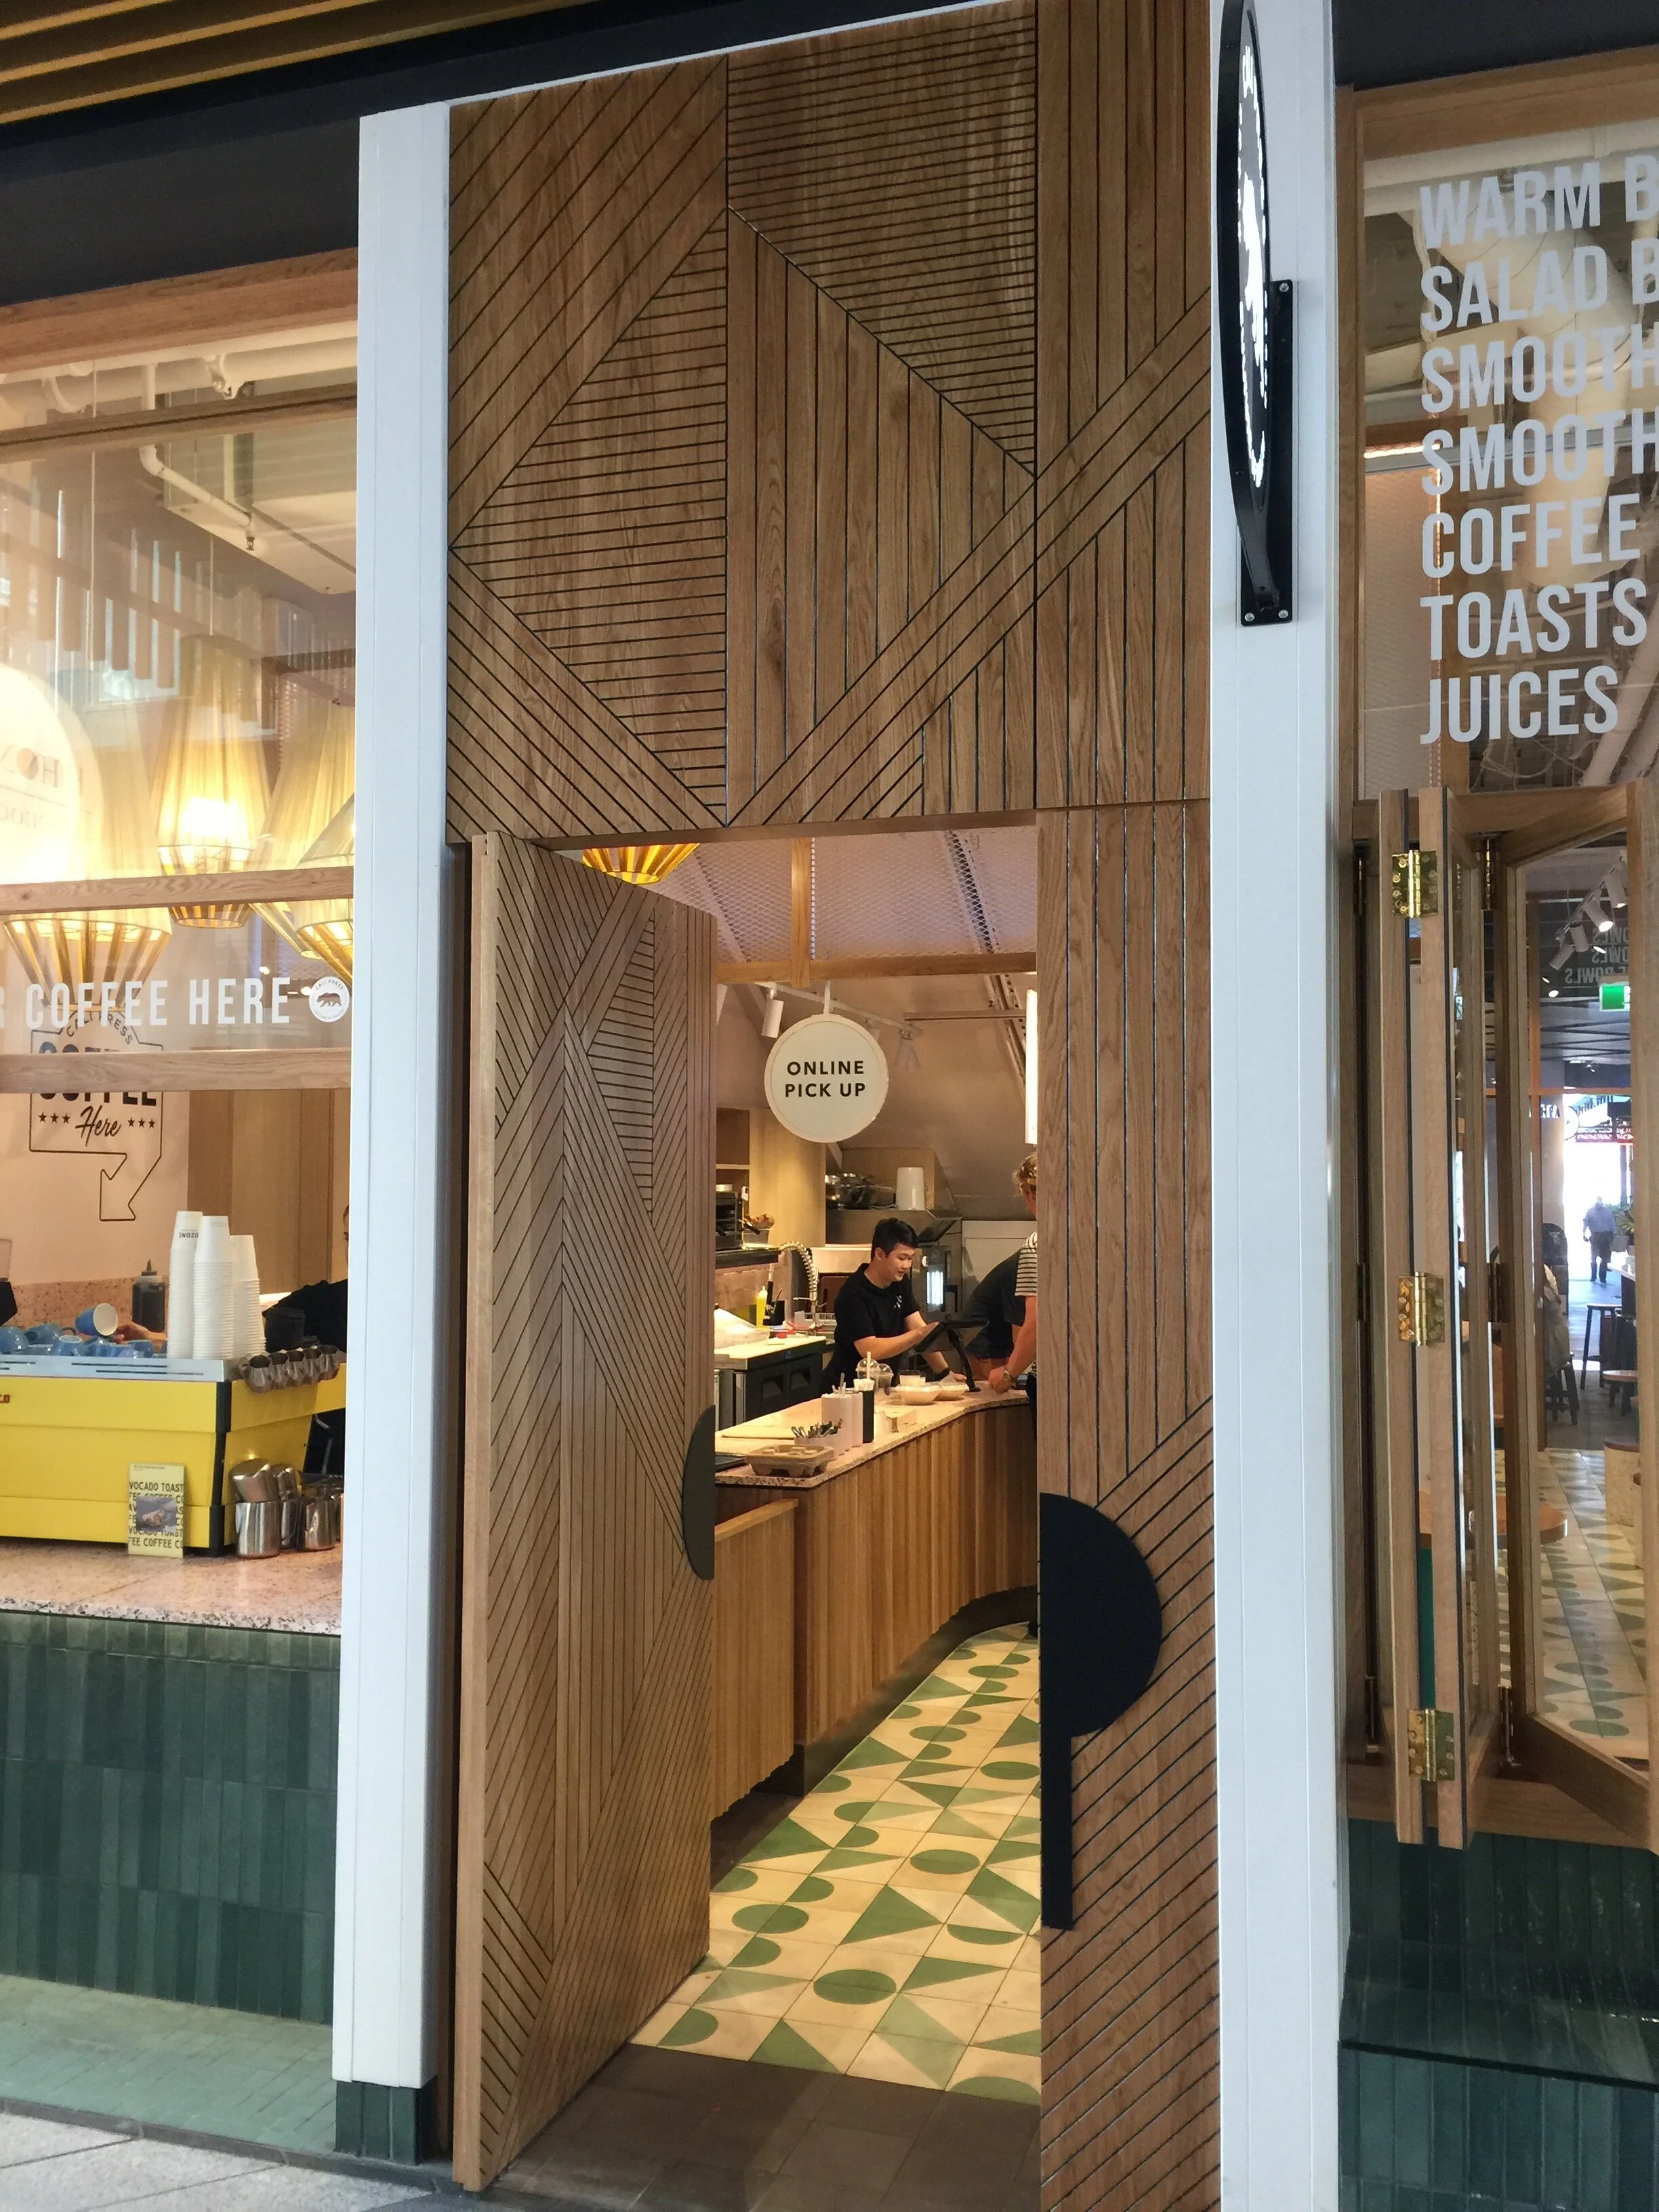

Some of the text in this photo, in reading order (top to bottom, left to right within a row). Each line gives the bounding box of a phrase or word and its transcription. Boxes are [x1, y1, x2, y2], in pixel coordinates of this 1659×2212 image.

[1420, 161, 1601, 249] WARM
[1420, 245, 1607, 332] SALAD
[1421, 321, 1659, 413] SMOOTH
[1421, 405, 1659, 496] SMOOTH
[1422, 493, 1641, 579] COFFEE
[1419, 577, 1647, 661] TOASTS
[1419, 665, 1619, 745] JUICES
[26, 980, 168, 1029] COFFEE
[189, 977, 291, 1025] HERE
[785, 1082, 865, 1098] PICK UP
[787, 1061, 864, 1076] ONLINE
[75, 1105, 122, 1147] Here
